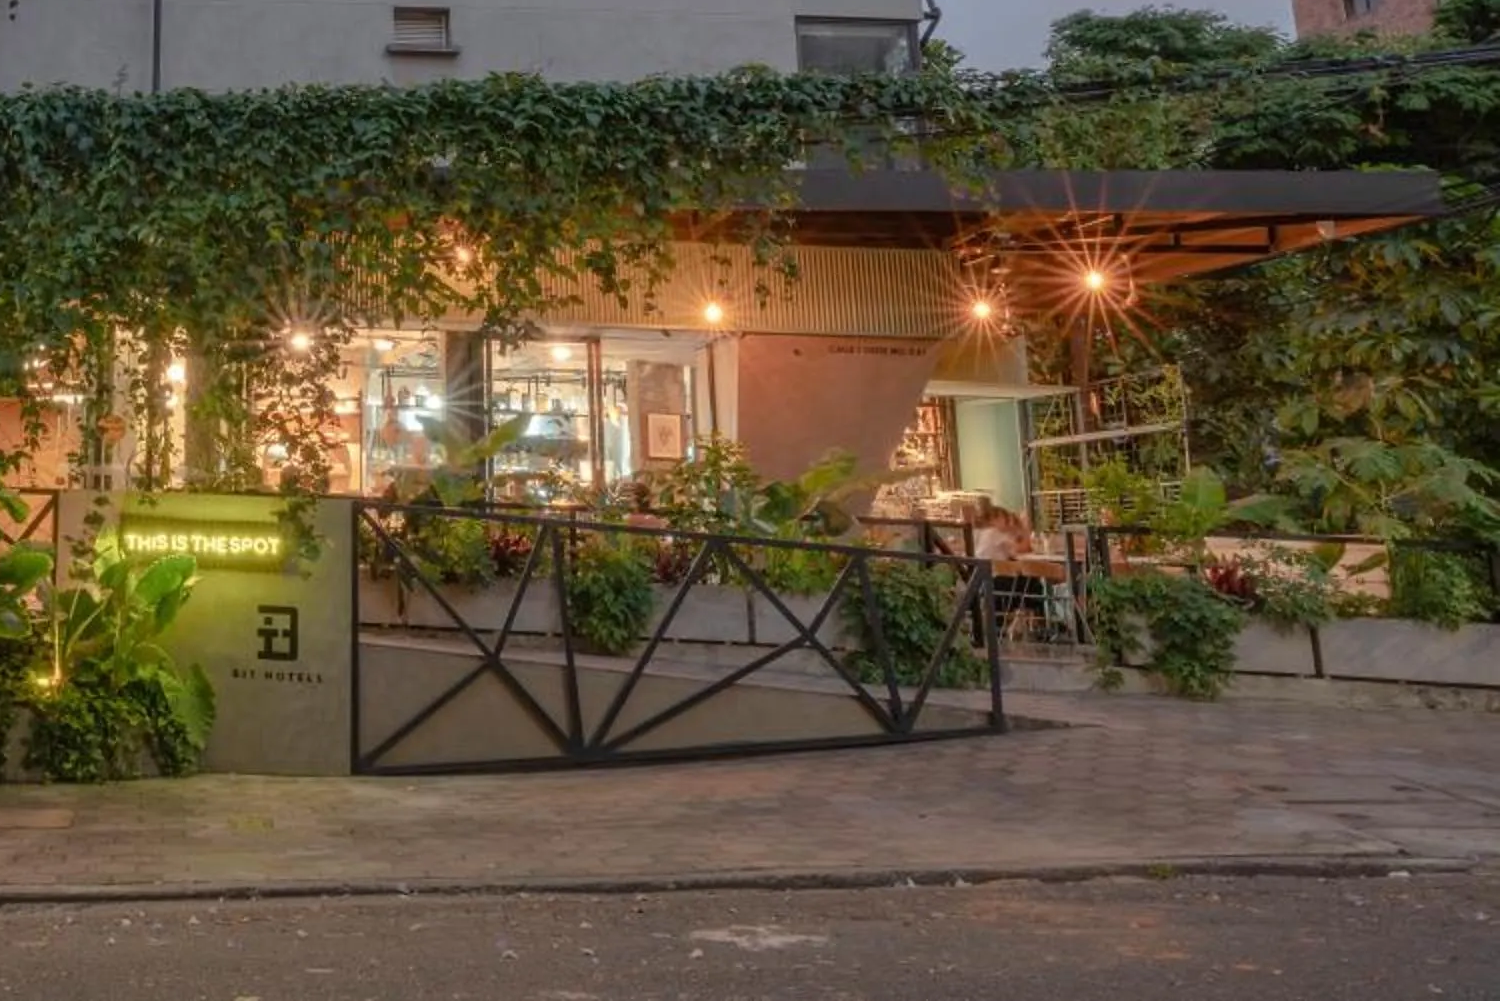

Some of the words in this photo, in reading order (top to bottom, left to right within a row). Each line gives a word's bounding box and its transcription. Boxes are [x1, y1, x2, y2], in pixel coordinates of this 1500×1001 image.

[124, 533, 169, 551] THIS
[171, 534, 189, 551] IS
[190, 535, 229, 554] THE
[229, 536, 280, 555] SPOT
